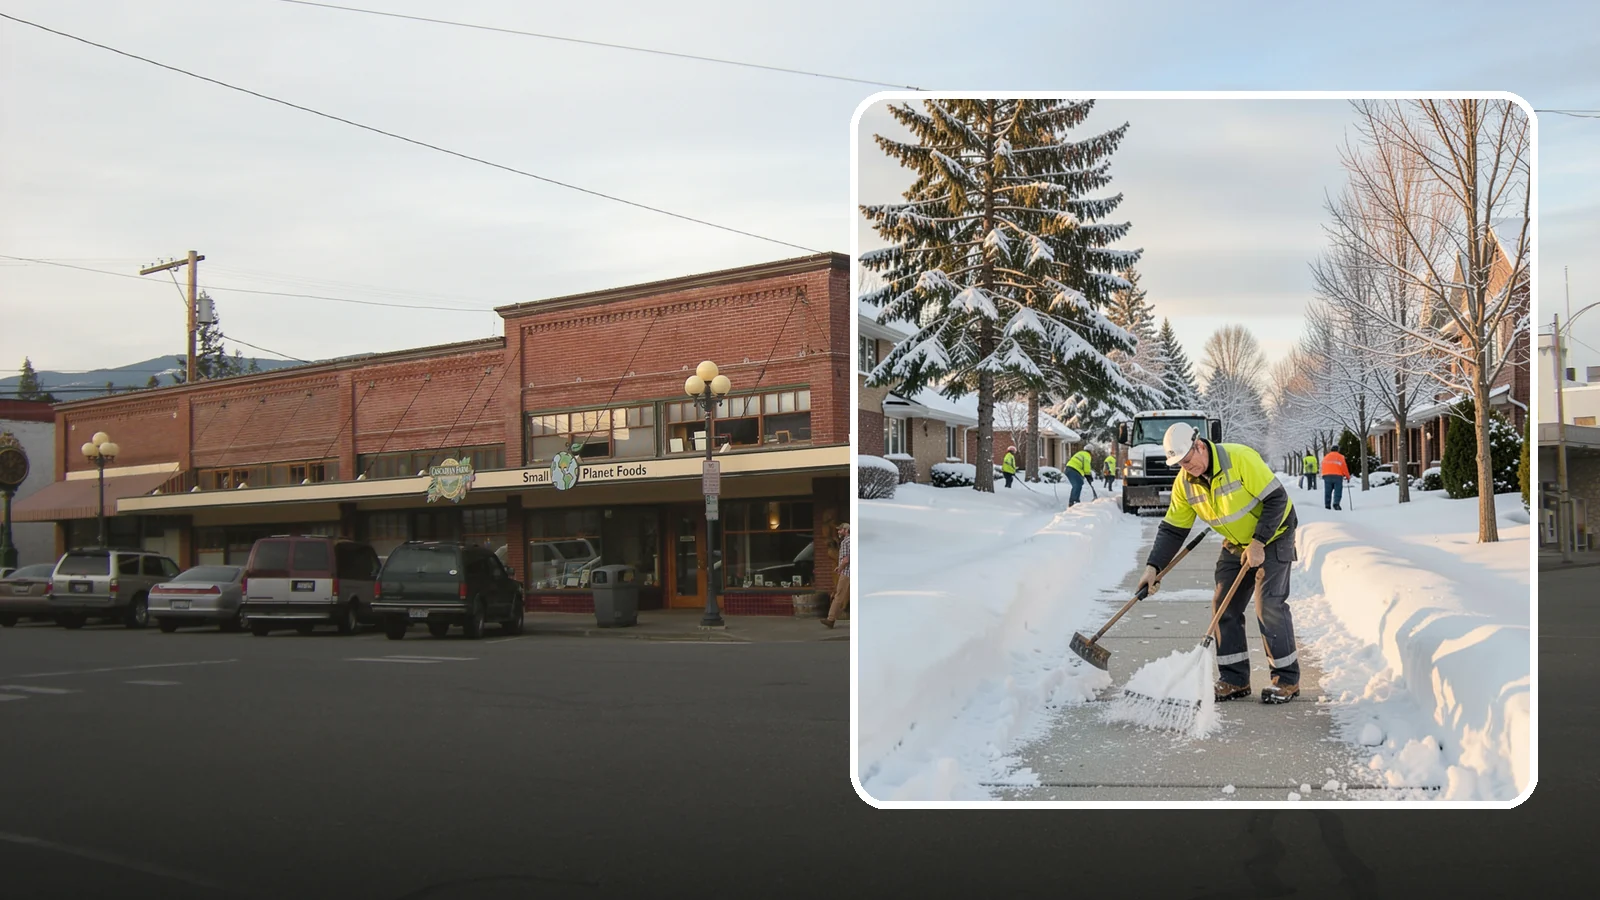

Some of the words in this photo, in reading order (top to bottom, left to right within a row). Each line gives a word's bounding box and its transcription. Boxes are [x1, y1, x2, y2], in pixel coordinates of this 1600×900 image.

[523, 471, 549, 483] Small
[583, 467, 614, 479] Planet
[617, 464, 647, 477] Foods
